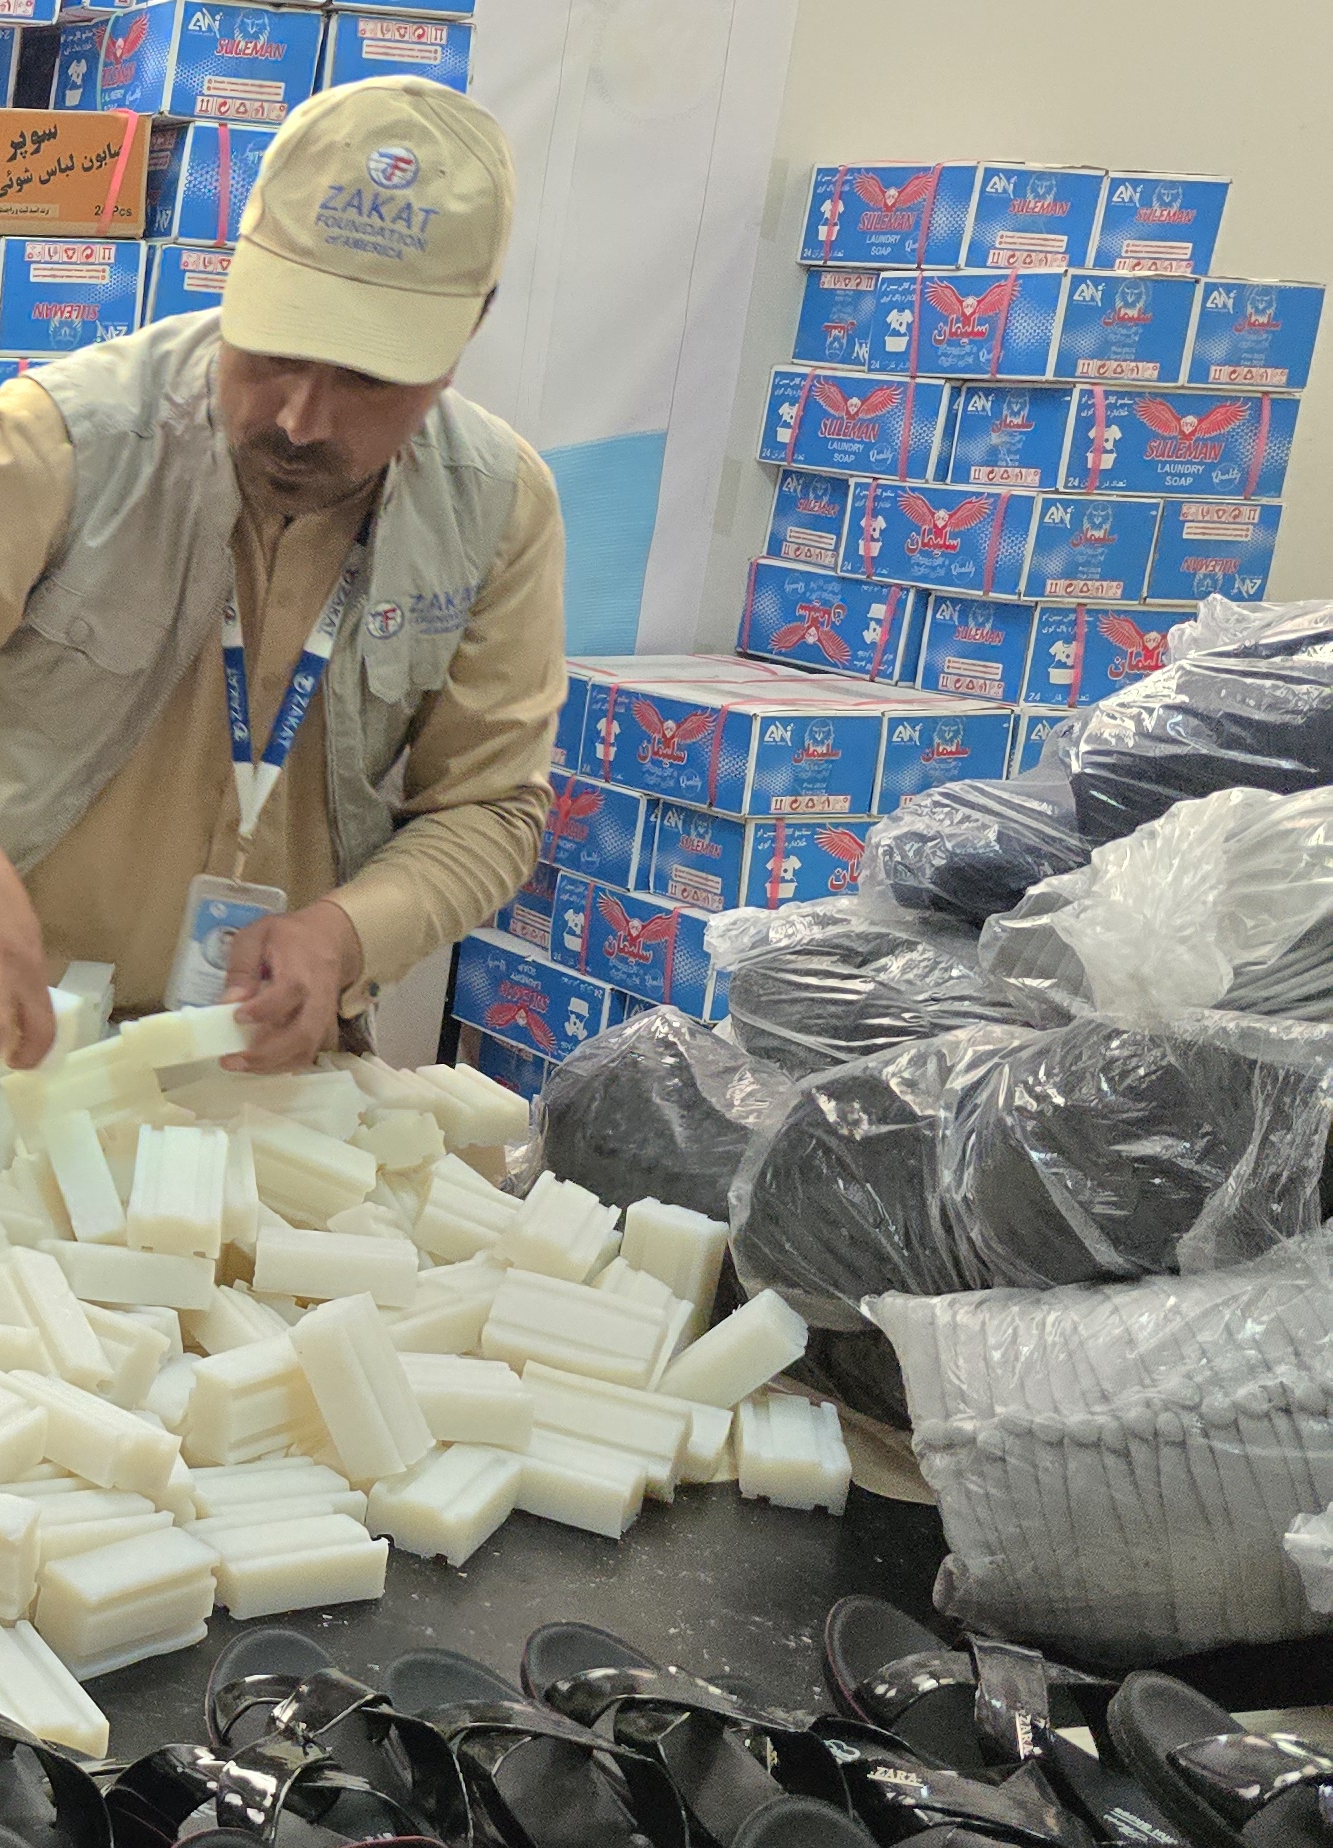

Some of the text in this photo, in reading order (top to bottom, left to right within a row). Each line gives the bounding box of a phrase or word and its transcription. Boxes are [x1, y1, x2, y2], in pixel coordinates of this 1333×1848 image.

[216, 38, 287, 59] SULEMAN
[319, 184, 440, 233] ZAKAT
[1009, 198, 1070, 216] SULEMAN
[1135, 207, 1196, 224] SULEMAN
[857, 212, 917, 231] SULEMAN
[871, 246, 892, 255] SOAP
[33, 302, 100, 320] SULEMAN
[818, 418, 881, 442] SULEMAN
[828, 442, 864, 453] LAUNDRY
[1144, 440, 1225, 463] SULEMAN
[833, 452, 855, 463] SOAP
[1158, 463, 1205, 474] LAUNDRY
[1165, 476, 1194, 486] SOAP
[954, 626, 1005, 644] SULEMAN
